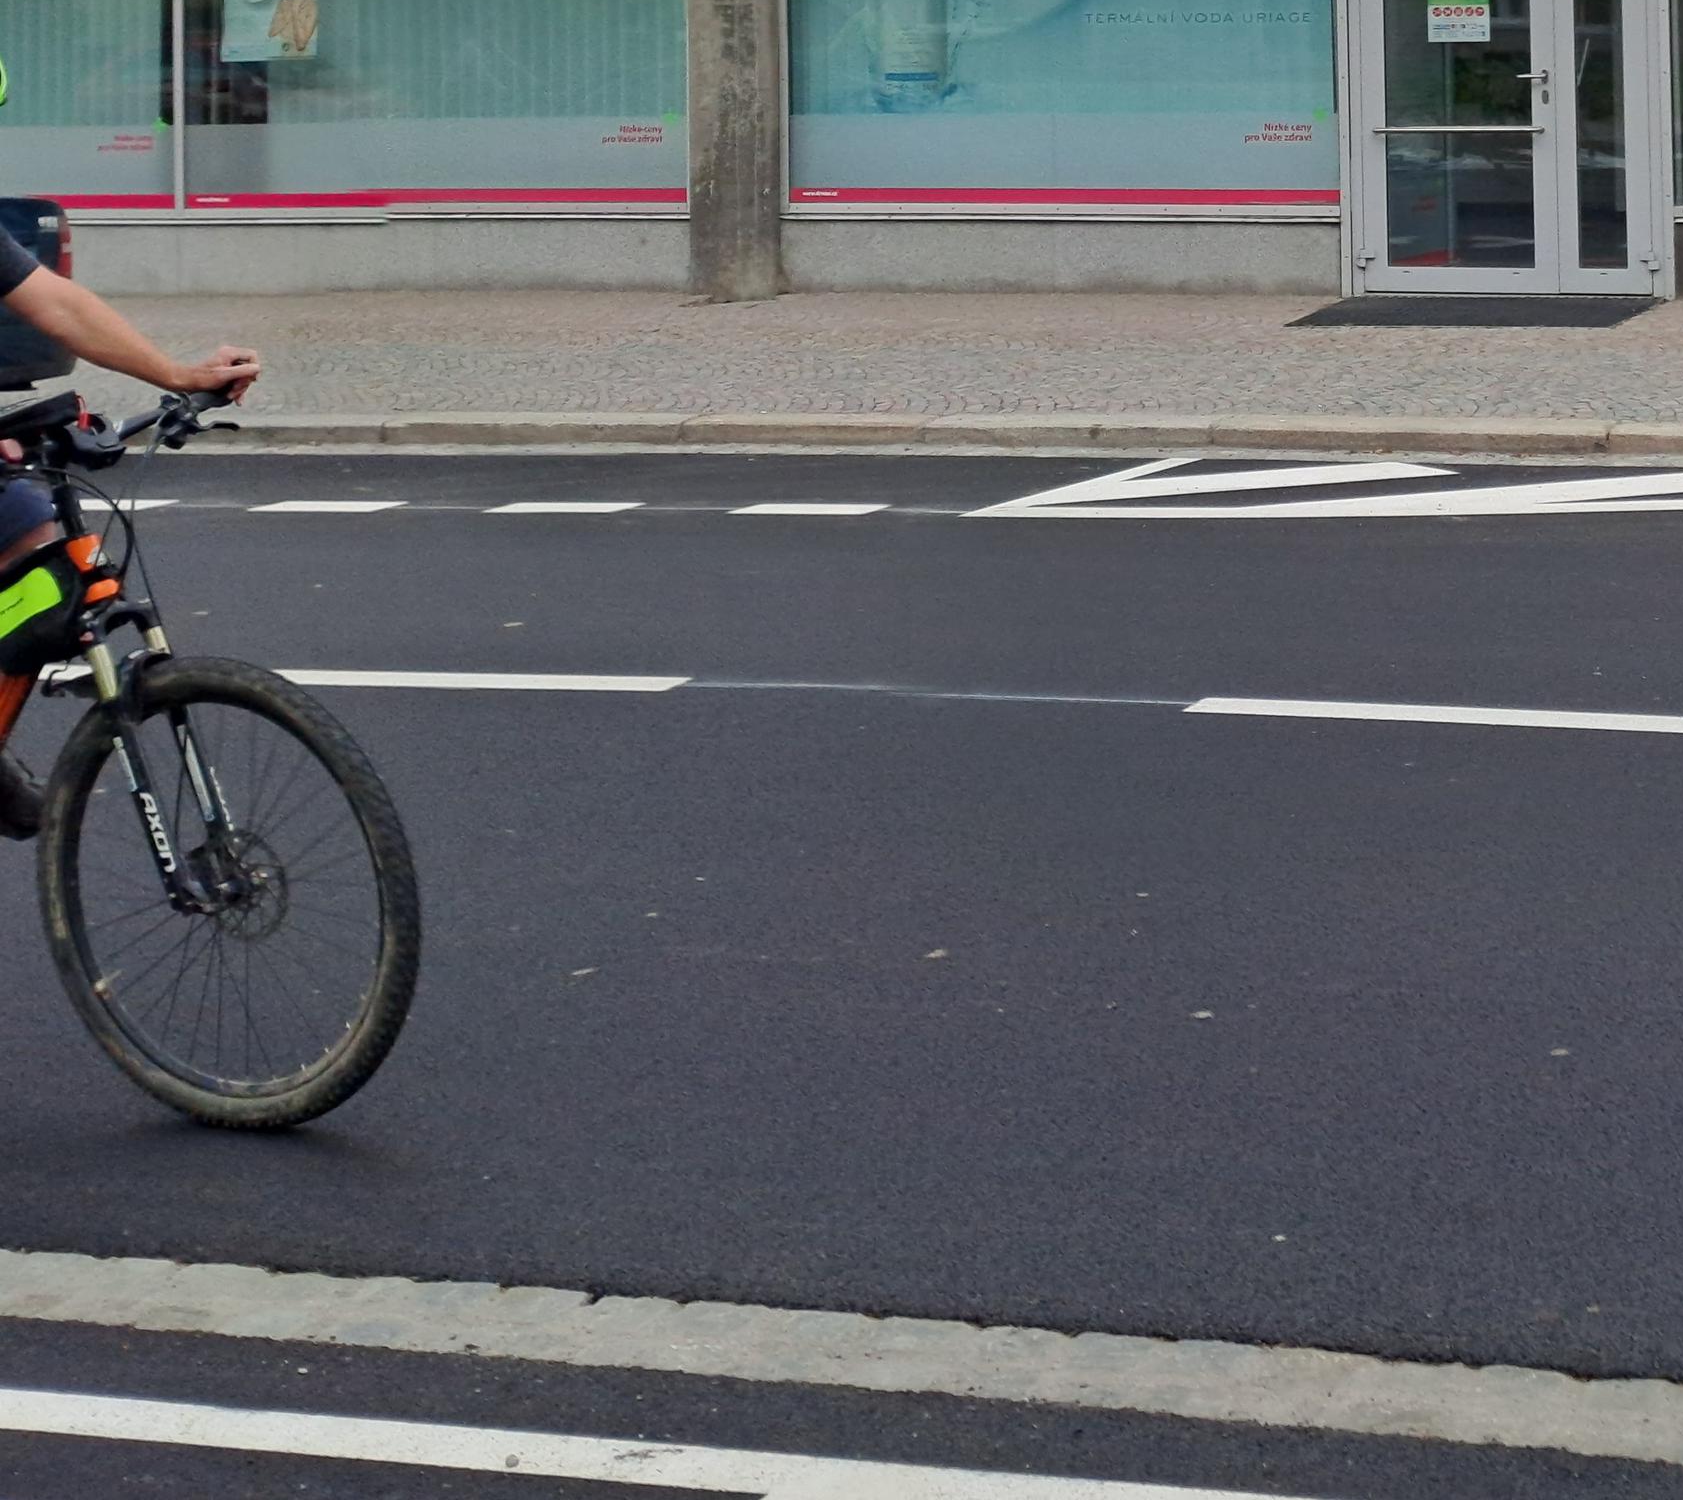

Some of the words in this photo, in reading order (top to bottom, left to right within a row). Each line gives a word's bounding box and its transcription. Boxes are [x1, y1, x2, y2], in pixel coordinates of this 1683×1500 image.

[1182, 12, 1234, 24] VODA
[1242, 11, 1312, 24] URIAGE
[139, 792, 177, 874] AXON
